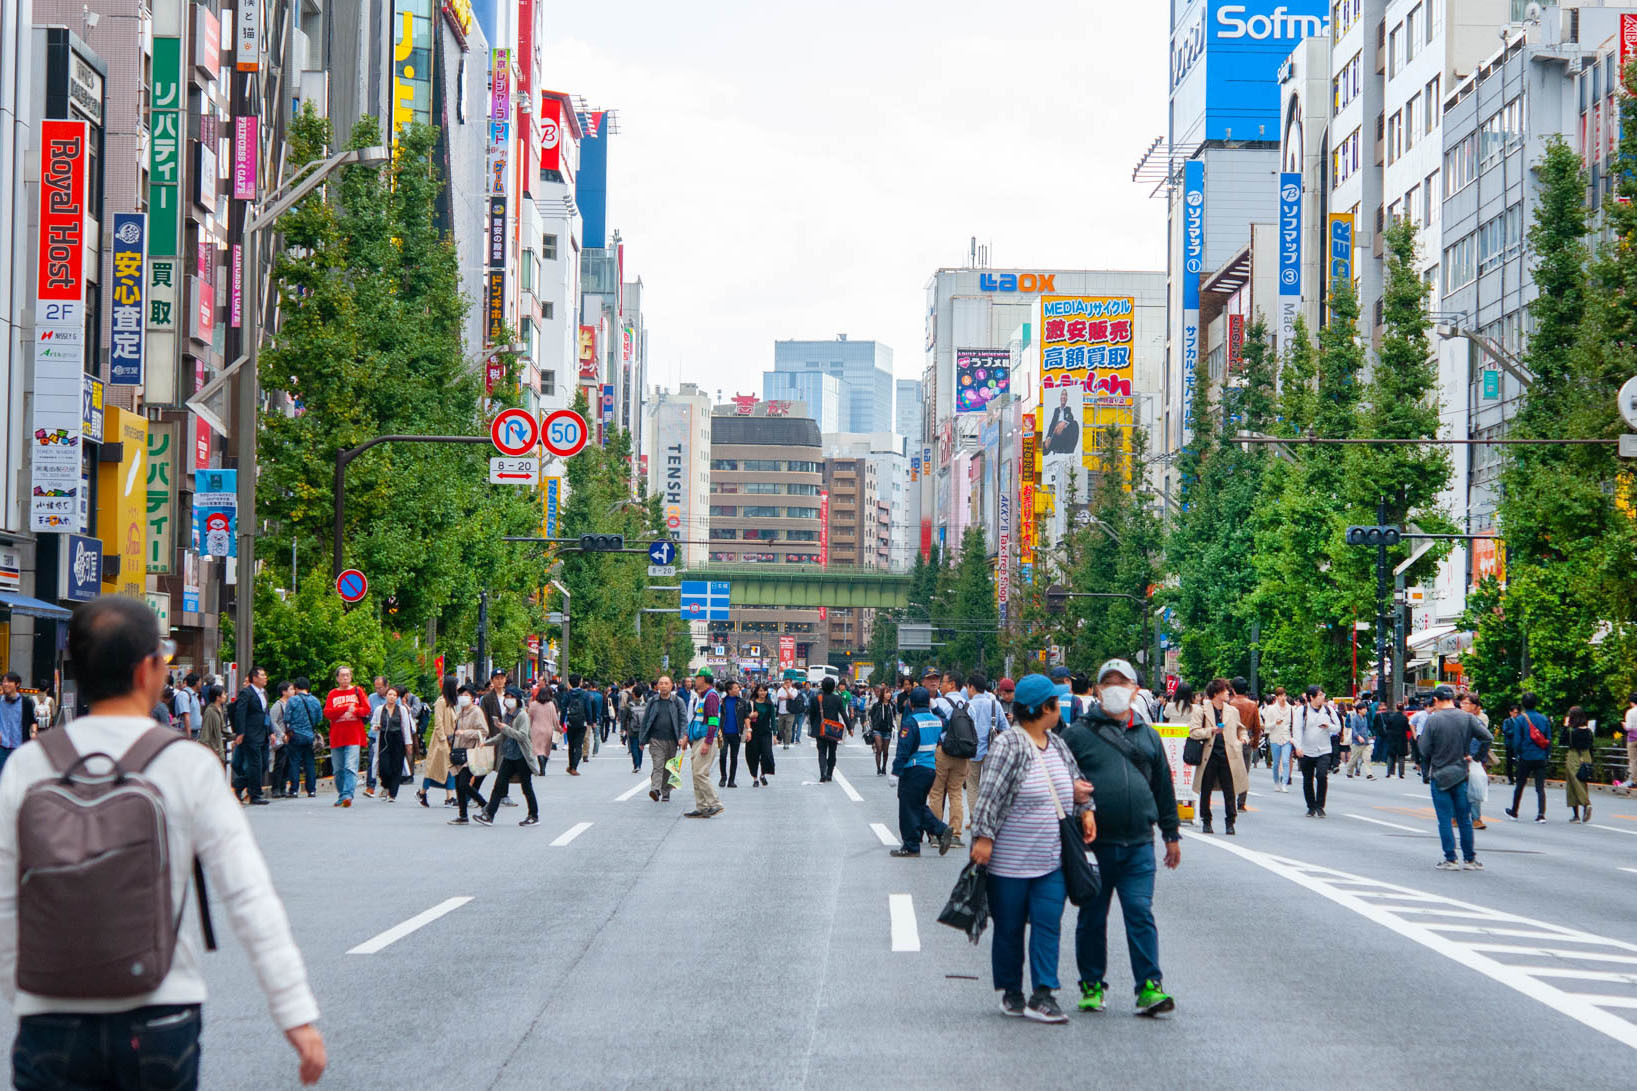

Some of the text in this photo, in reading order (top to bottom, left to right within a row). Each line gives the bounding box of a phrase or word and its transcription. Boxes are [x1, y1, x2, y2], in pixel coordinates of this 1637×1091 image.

[154, 81, 177, 209] リバティー
[48, 137, 80, 288] Royal Host
[1188, 207, 1201, 256] ソフマップ
[1283, 206, 1297, 264] ソフマップ
[46, 304, 73, 320] 2F
[112, 250, 142, 359] 安心査定
[150, 262, 172, 324] 買取
[1044, 299, 1131, 318] MEDIAリサイクル
[1045, 320, 1132, 342] 激安販売
[1284, 303, 1295, 332] Mac
[1044, 346, 1130, 370] 高額買取
[551, 423, 577, 443] 50
[147, 434, 170, 562] リバティー
[1000, 533, 1008, 575] Tax-free
